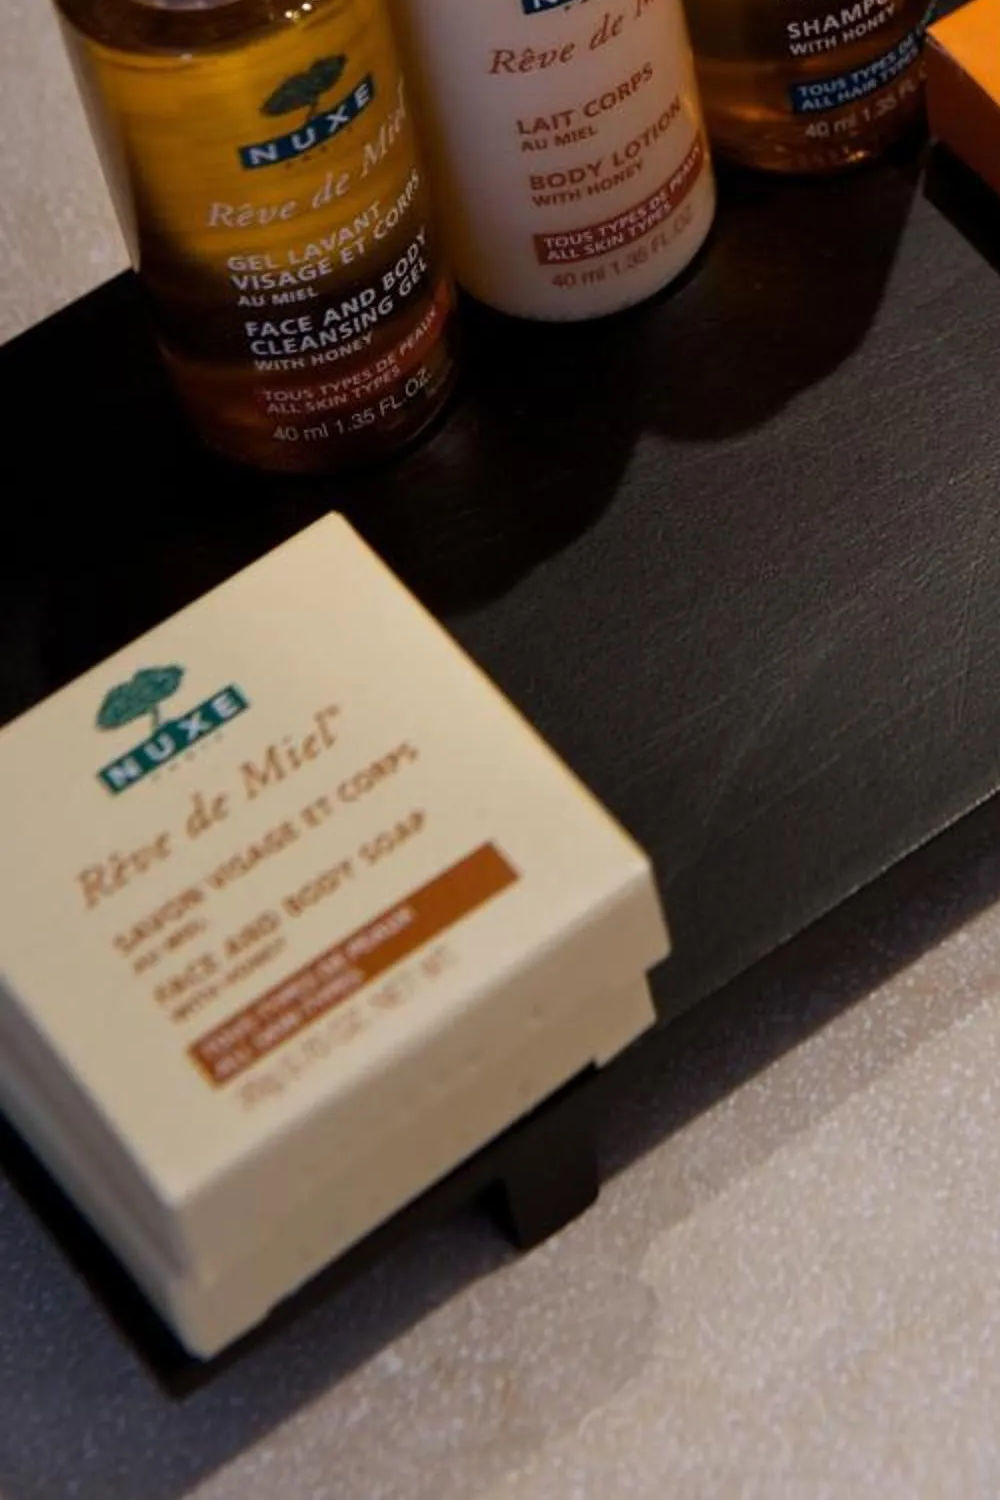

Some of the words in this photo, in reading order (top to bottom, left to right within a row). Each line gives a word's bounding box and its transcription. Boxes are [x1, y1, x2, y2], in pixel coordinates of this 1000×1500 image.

[488, 42, 576, 75] Rêve
[589, 12, 624, 51] de
[789, 36, 837, 56] WITH
[842, 2, 897, 44] HONEY
[516, 109, 576, 136] LAIT
[583, 61, 654, 118] CORPS
[796, 76, 847, 97] TOUS
[801, 96, 834, 111] ALL
[837, 79, 878, 100] HAIR
[208, 200, 298, 227] Rêve
[311, 171, 351, 209] de
[360, 76, 406, 180] Miel
[248, 83, 370, 165] NUXE
[520, 139, 549, 153] AU
[554, 124, 598, 148] MIEL
[529, 155, 603, 192] BODY
[612, 94, 682, 167] LOTION
[805, 121, 830, 138] 40
[833, 111, 858, 133] ml
[531, 188, 581, 208] WITH
[586, 156, 644, 196] HONEY
[226, 254, 280, 272] GEL
[288, 201, 380, 265] LAVANT
[230, 257, 333, 291] VISAGE
[341, 236, 366, 265] ET
[373, 168, 420, 240] CORPS
[543, 230, 594, 249] TOUS
[599, 208, 647, 238] TYPES
[547, 248, 581, 261] ALL
[583, 233, 624, 258] SKIN
[627, 201, 672, 238] TYPES
[237, 294, 266, 308] AU
[271, 286, 319, 305] MIEL
[244, 314, 313, 338] FACE
[322, 287, 376, 327] AND
[381, 225, 427, 293] BODY
[249, 295, 394, 356] CLEANSING
[398, 257, 428, 298] GEL
[551, 271, 577, 288] 40
[580, 266, 607, 287] ml
[254, 357, 305, 371] WITH
[310, 330, 374, 367] HONEY
[263, 386, 314, 401] TOUS
[319, 367, 372, 395] TYPES
[376, 352, 397, 373] DE
[265, 401, 302, 414] ALL
[306, 393, 349, 414] SKIN
[351, 365, 401, 399] TYPES
[271, 425, 300, 442] 40
[303, 423, 330, 442] ml
[335, 407, 376, 435] 1.35
[107, 692, 241, 787] NUXE
[77, 831, 171, 910] Rêve
[187, 791, 229, 838] de
[113, 887, 204, 953] SAVON
[208, 820, 298, 889] VISAGE
[301, 796, 332, 827] ET
[337, 742, 418, 802] CORPS
[153, 954, 216, 1004] FACE
[224, 910, 280, 955] AND
[282, 859, 353, 917] BODY
[358, 809, 424, 867] SOAP
